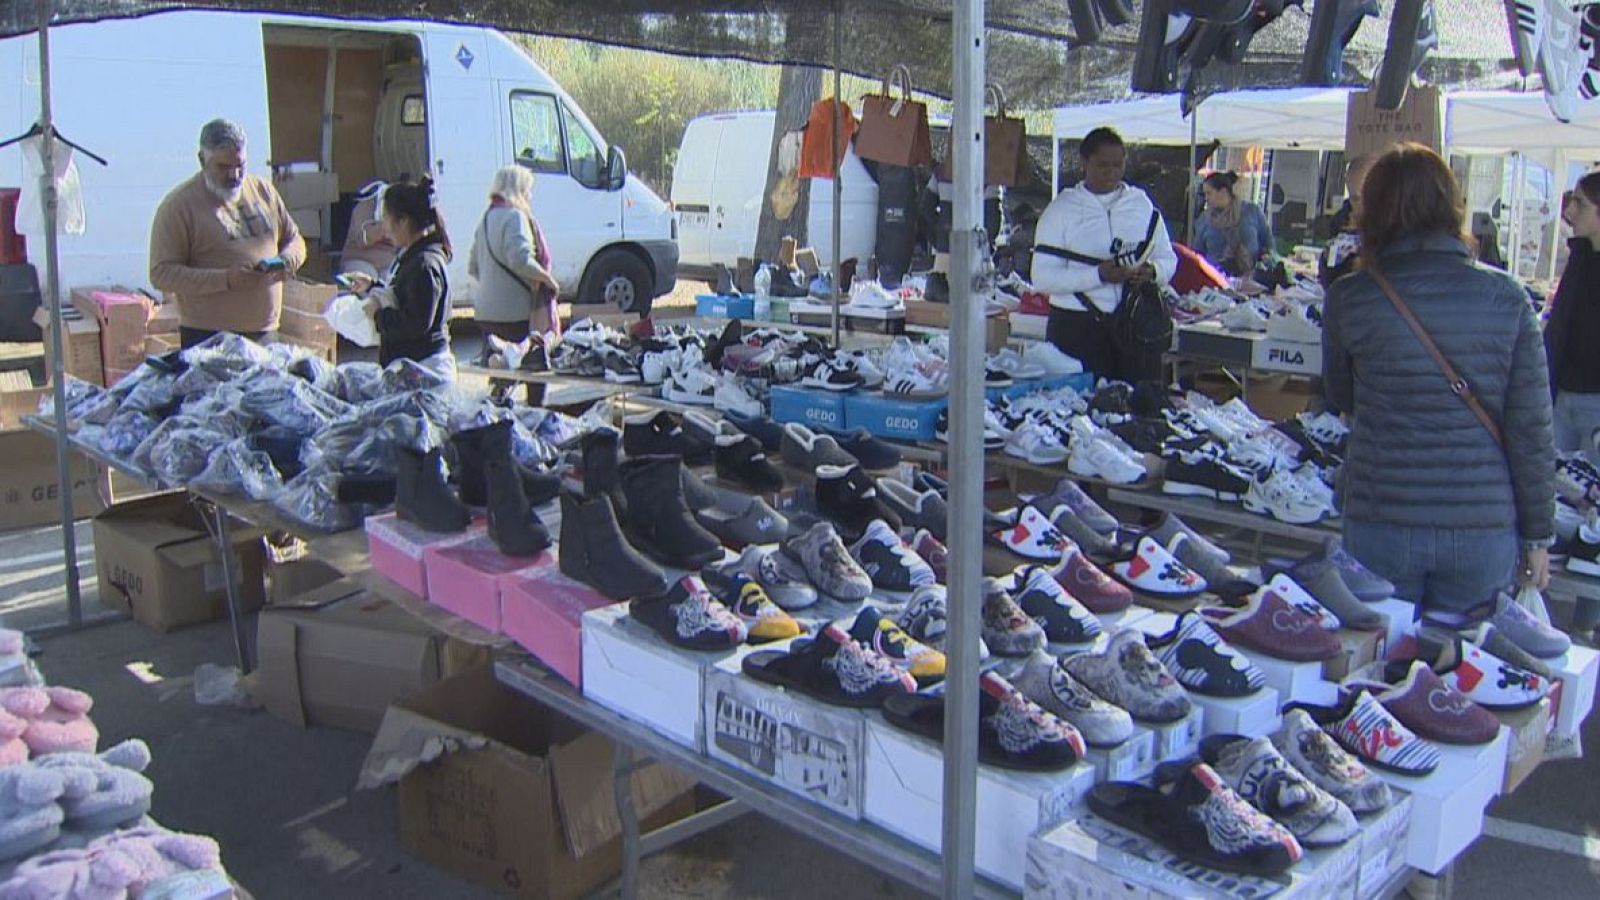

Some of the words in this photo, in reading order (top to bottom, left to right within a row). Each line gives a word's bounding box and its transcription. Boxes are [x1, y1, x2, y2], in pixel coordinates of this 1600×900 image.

[1379, 111, 1402, 121] THE
[1357, 123, 1388, 133] TOTE
[1395, 122, 1422, 132] BAG
[1268, 348, 1305, 365] FILA
[805, 407, 837, 423] GEDO
[885, 416, 919, 431] GEDO
